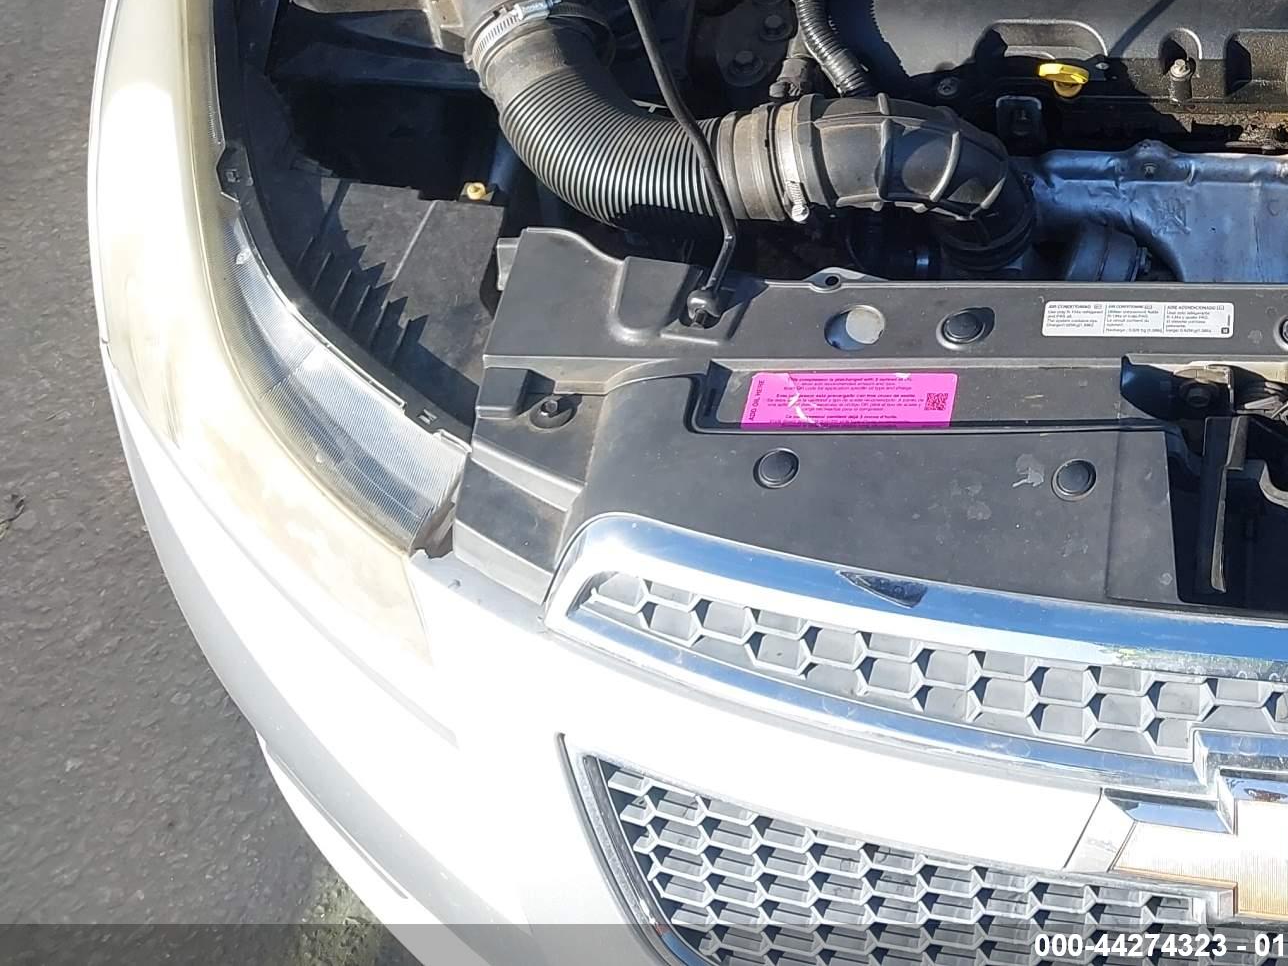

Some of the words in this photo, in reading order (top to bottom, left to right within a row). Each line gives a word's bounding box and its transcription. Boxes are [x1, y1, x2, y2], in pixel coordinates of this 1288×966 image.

[756, 380, 765, 396] HERE
[752, 397, 761, 406] OIL
[748, 409, 758, 421] ADD
